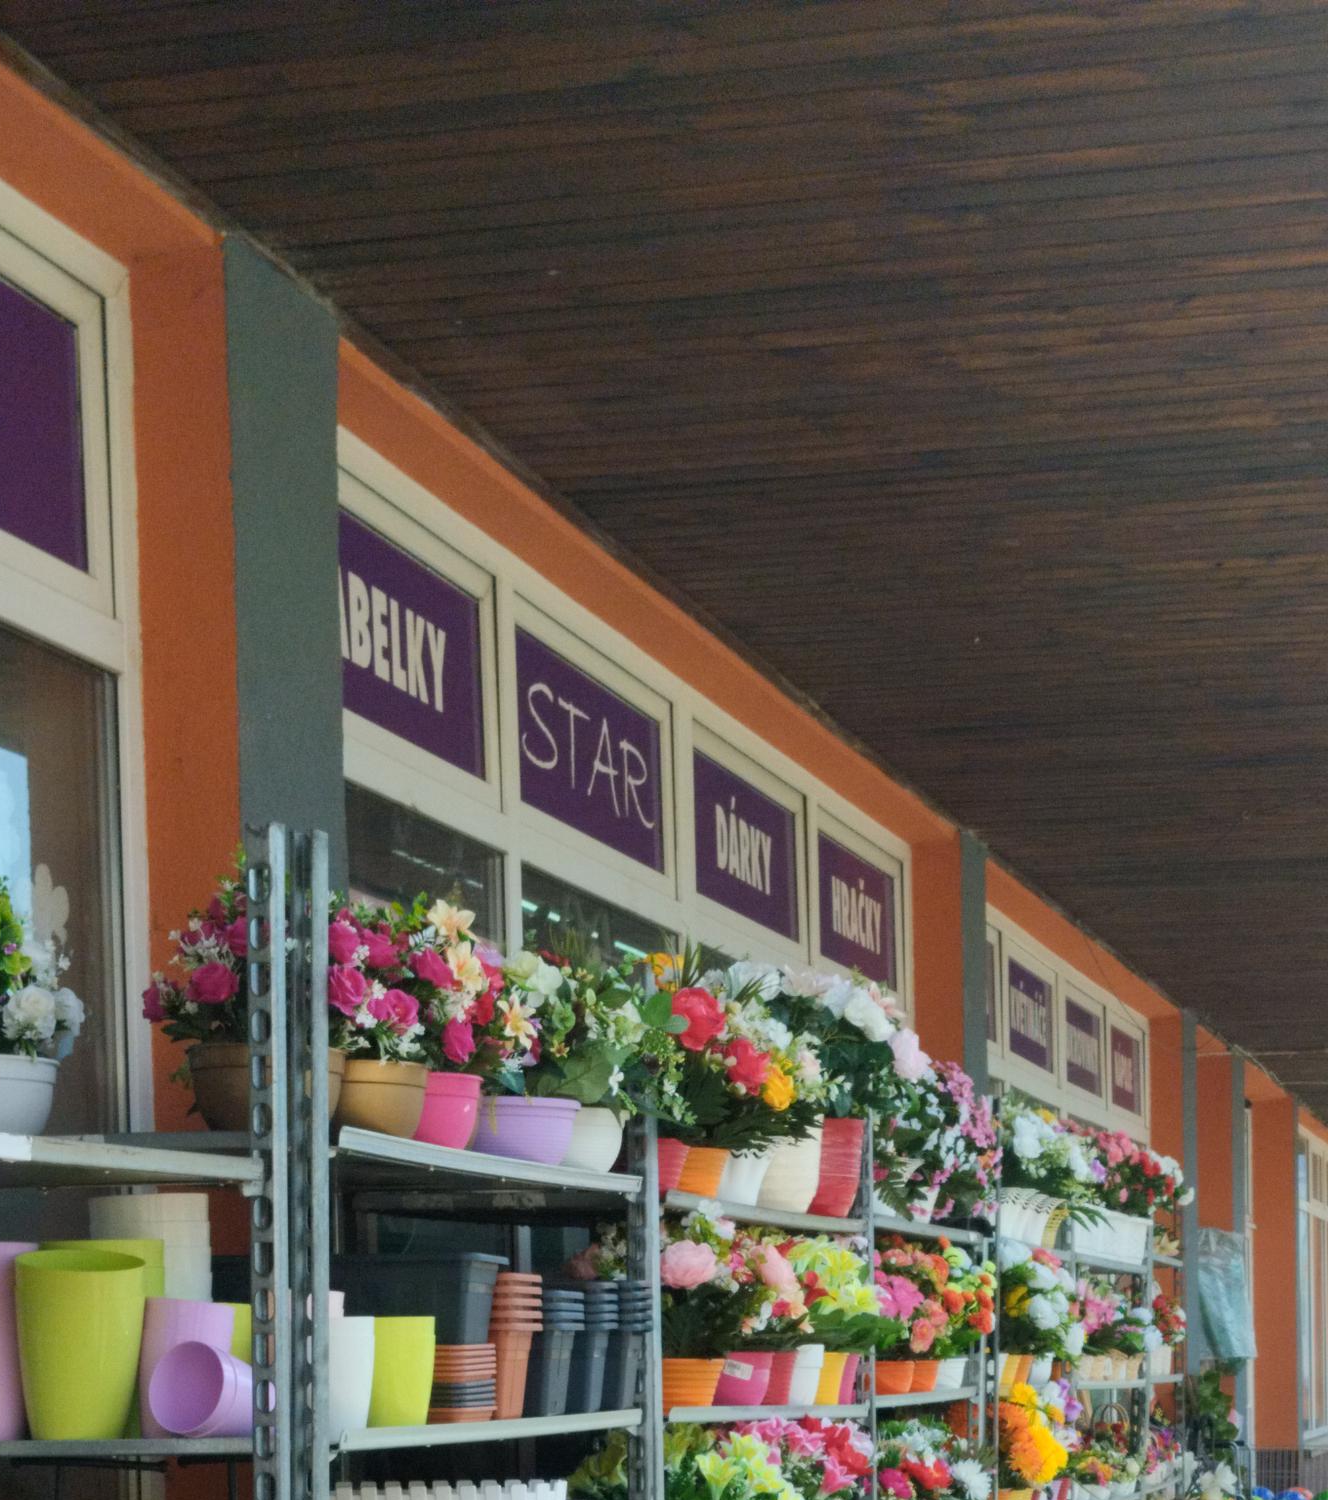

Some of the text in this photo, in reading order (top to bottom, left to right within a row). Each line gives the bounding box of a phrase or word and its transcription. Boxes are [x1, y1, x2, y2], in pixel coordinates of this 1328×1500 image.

[339, 566, 446, 713] BELKY
[522, 682, 655, 829] STAR
[715, 795, 771, 896] DÁRKY
[831, 875, 882, 956] HRAČKY
